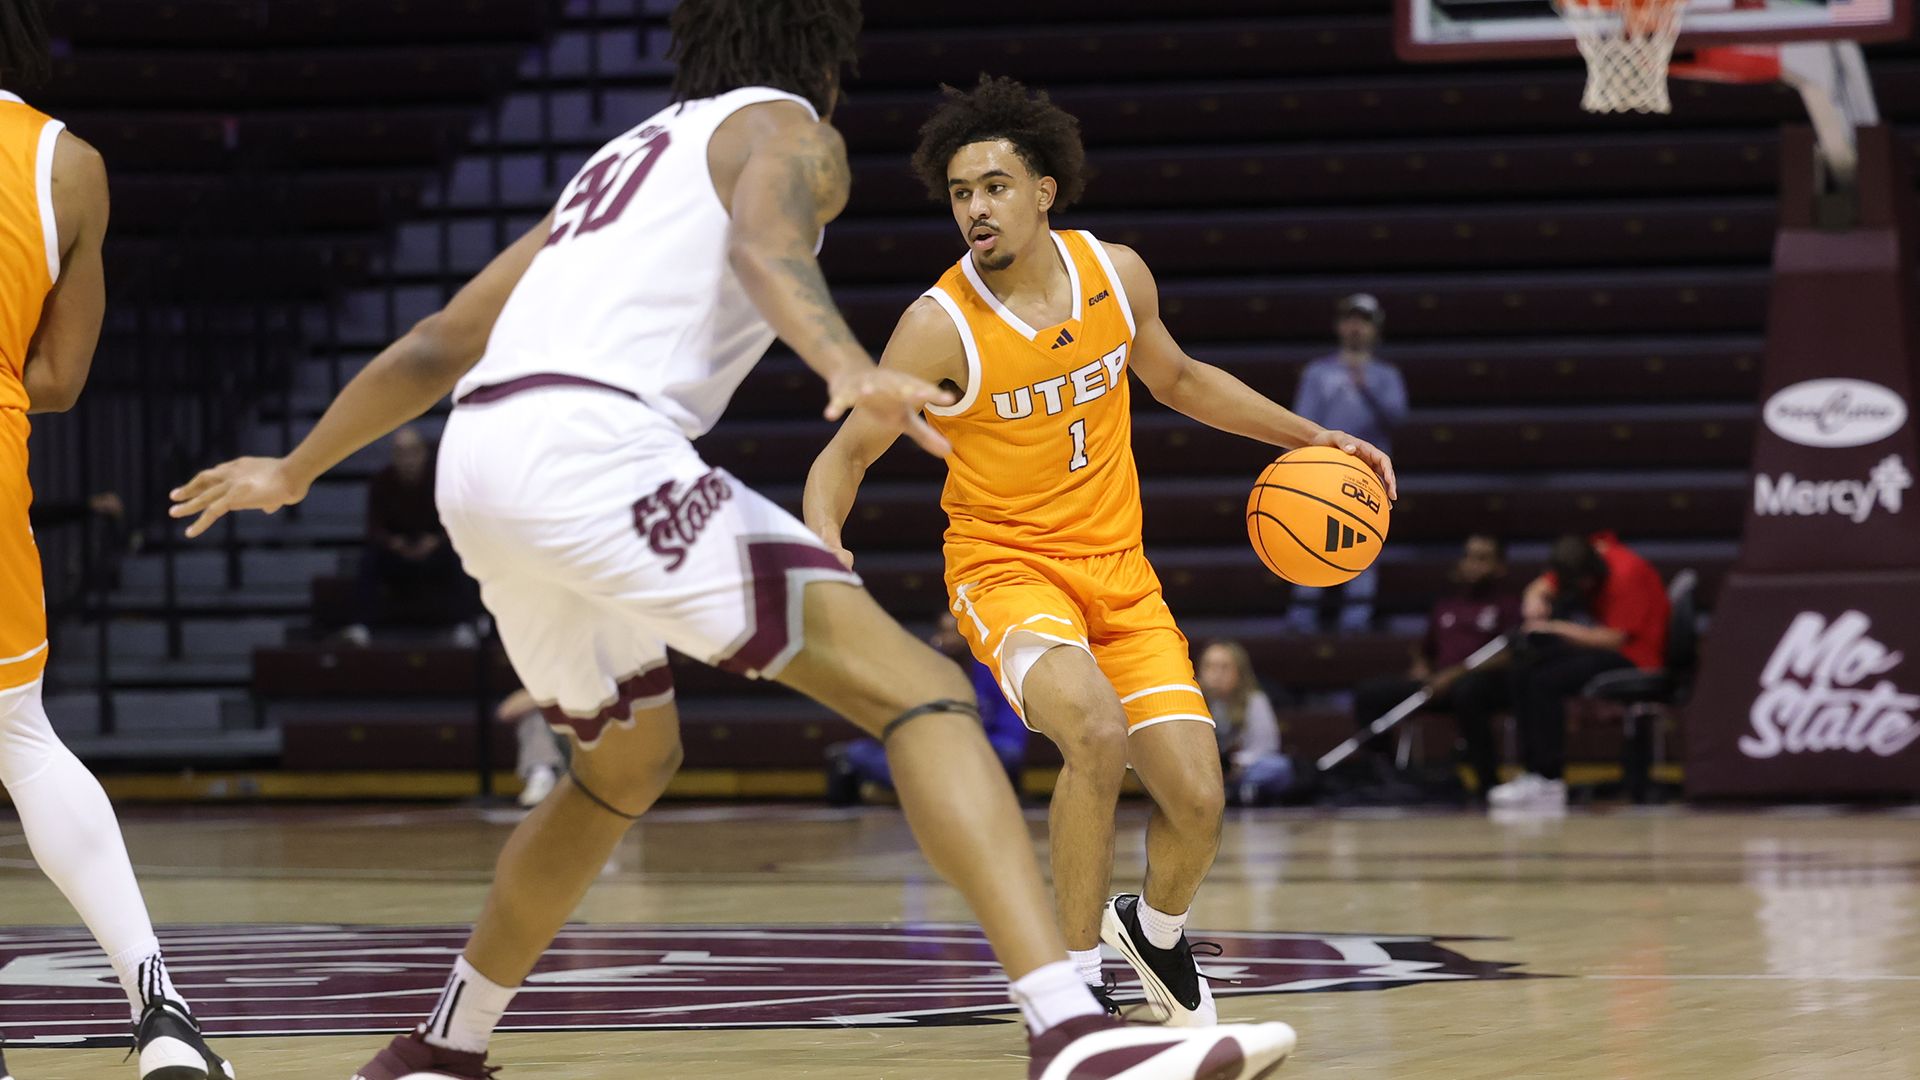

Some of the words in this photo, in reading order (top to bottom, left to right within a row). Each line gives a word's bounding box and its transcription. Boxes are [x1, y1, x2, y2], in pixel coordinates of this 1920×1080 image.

[991, 341, 1128, 420] UTEP
[1068, 417, 1089, 474] 1
[647, 466, 734, 573] State
[1341, 482, 1381, 515] PRO
[1753, 471, 1879, 524] Mercy
[1758, 608, 1904, 689] Mo
[1737, 679, 1920, 760] State
